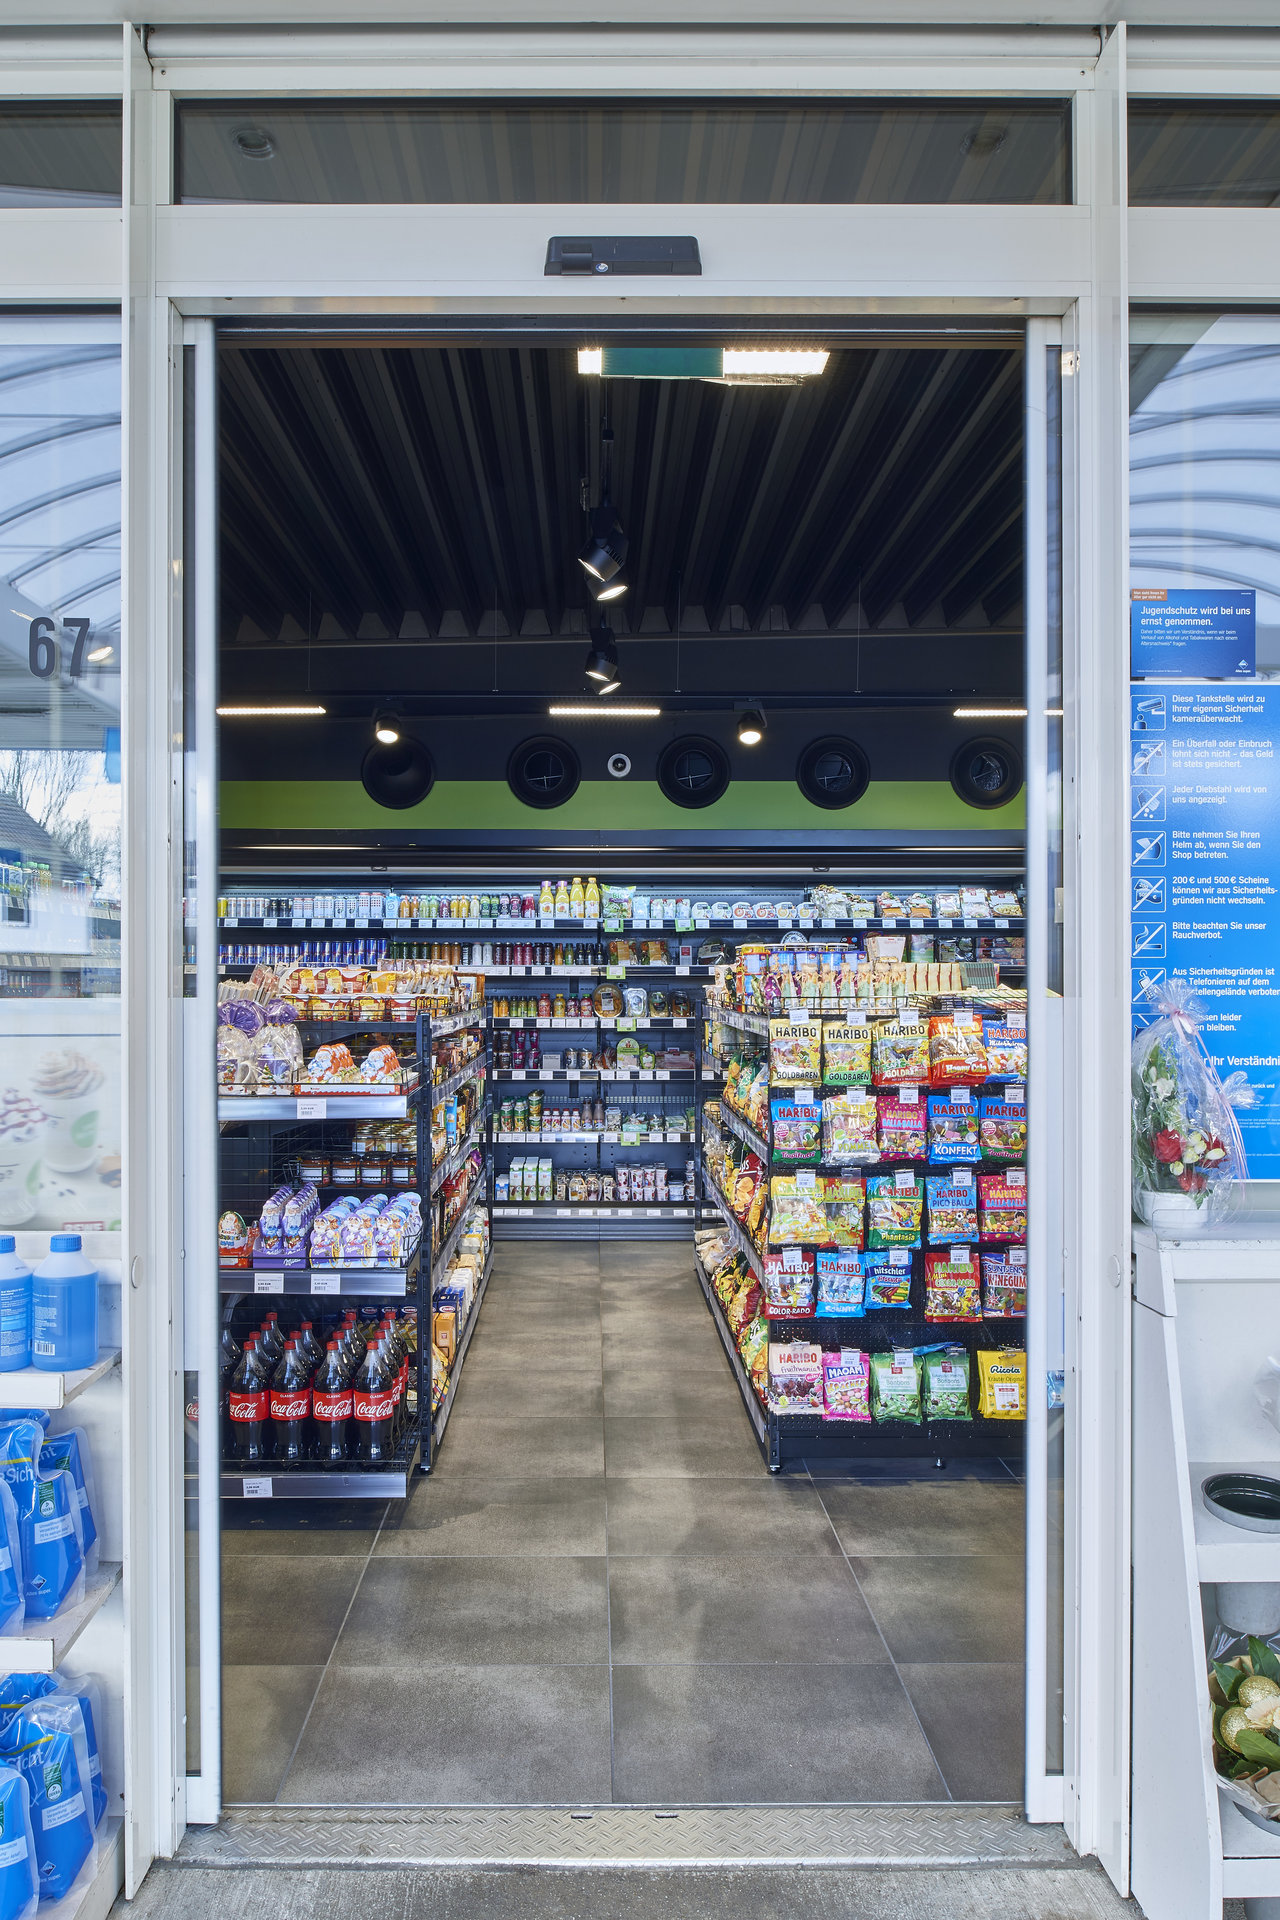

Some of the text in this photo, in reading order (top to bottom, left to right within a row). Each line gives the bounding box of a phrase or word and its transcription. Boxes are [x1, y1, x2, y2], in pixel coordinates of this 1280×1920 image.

[1140, 606, 1251, 616] Jugendschutz wird bei uns
[1140, 617, 1213, 627] ernst genommen.
[29, 616, 90, 678] 67
[1172, 694, 1193, 703] Diese
[1196, 694, 1235, 703] Tankstelle
[1237, 694, 1254, 703] wird
[1172, 705, 1264, 714] Ihrer eigenen Sicherheit
[1172, 715, 1243, 723] kameraüberwacht.
[1172, 738, 1272, 748] Ein Überfall oder Einbruch
[1204, 760, 1242, 769] gesichert.
[1172, 785, 1194, 793] Jeder
[1196, 785, 1232, 793] Diebstahl
[1234, 785, 1251, 793] wird
[1188, 795, 1227, 805] angezeigt.
[1194, 841, 1207, 850] ab,
[1172, 851, 1229, 860] Shop betreten.
[1172, 876, 1269, 884] 200 € und 500 € Scheine
[1172, 886, 1200, 894] können
[1203, 886, 1214, 894] wir
[1233, 886, 1278, 894] Sicherheits-
[1172, 896, 1266, 906] gründen nicht wechseln.
[1172, 922, 1190, 930] Bitte
[1193, 922, 1228, 930] beachten
[1230, 922, 1242, 930] Sie
[1172, 931, 1223, 939] Rauchverbot.
[1189, 968, 1263, 977] Sicherheitsgründen
[1220, 1013, 1242, 1021] leider
[776, 1027, 817, 1037] HARIBO
[828, 1029, 869, 1039] HARIBO
[883, 1025, 925, 1036] HARIBO
[987, 1028, 1026, 1039] HARIBO
[1210, 1056, 1224, 1066] Ihr
[778, 1107, 818, 1118] HARIBO
[886, 1110, 918, 1119] HARIBO
[933, 1105, 975, 1115] HARIBO
[986, 1105, 1026, 1117] HARIBO
[935, 1146, 978, 1155] KONFEKT
[878, 1185, 919, 1197] HARIBO
[936, 1190, 968, 1198] HARIBO
[989, 1190, 1022, 1199] HARIBO
[951, 1199, 974, 1207] BALLA
[881, 1232, 915, 1241] Phantasia
[768, 1261, 809, 1273] HARIBO
[821, 1261, 861, 1274] HARIBO
[874, 1267, 906, 1275] hitschler
[934, 1262, 974, 1273] HARIBO
[769, 1307, 811, 1315] COLOR-RADO
[779, 1353, 817, 1363] HARIBO
[829, 1366, 864, 1378] MAOAM
[990, 1364, 1021, 1374] Ricola
[270, 1399, 308, 1416] Coca-Cola
[314, 1399, 352, 1417] Coca-Cola
[357, 1399, 394, 1417] Coca-Cola
